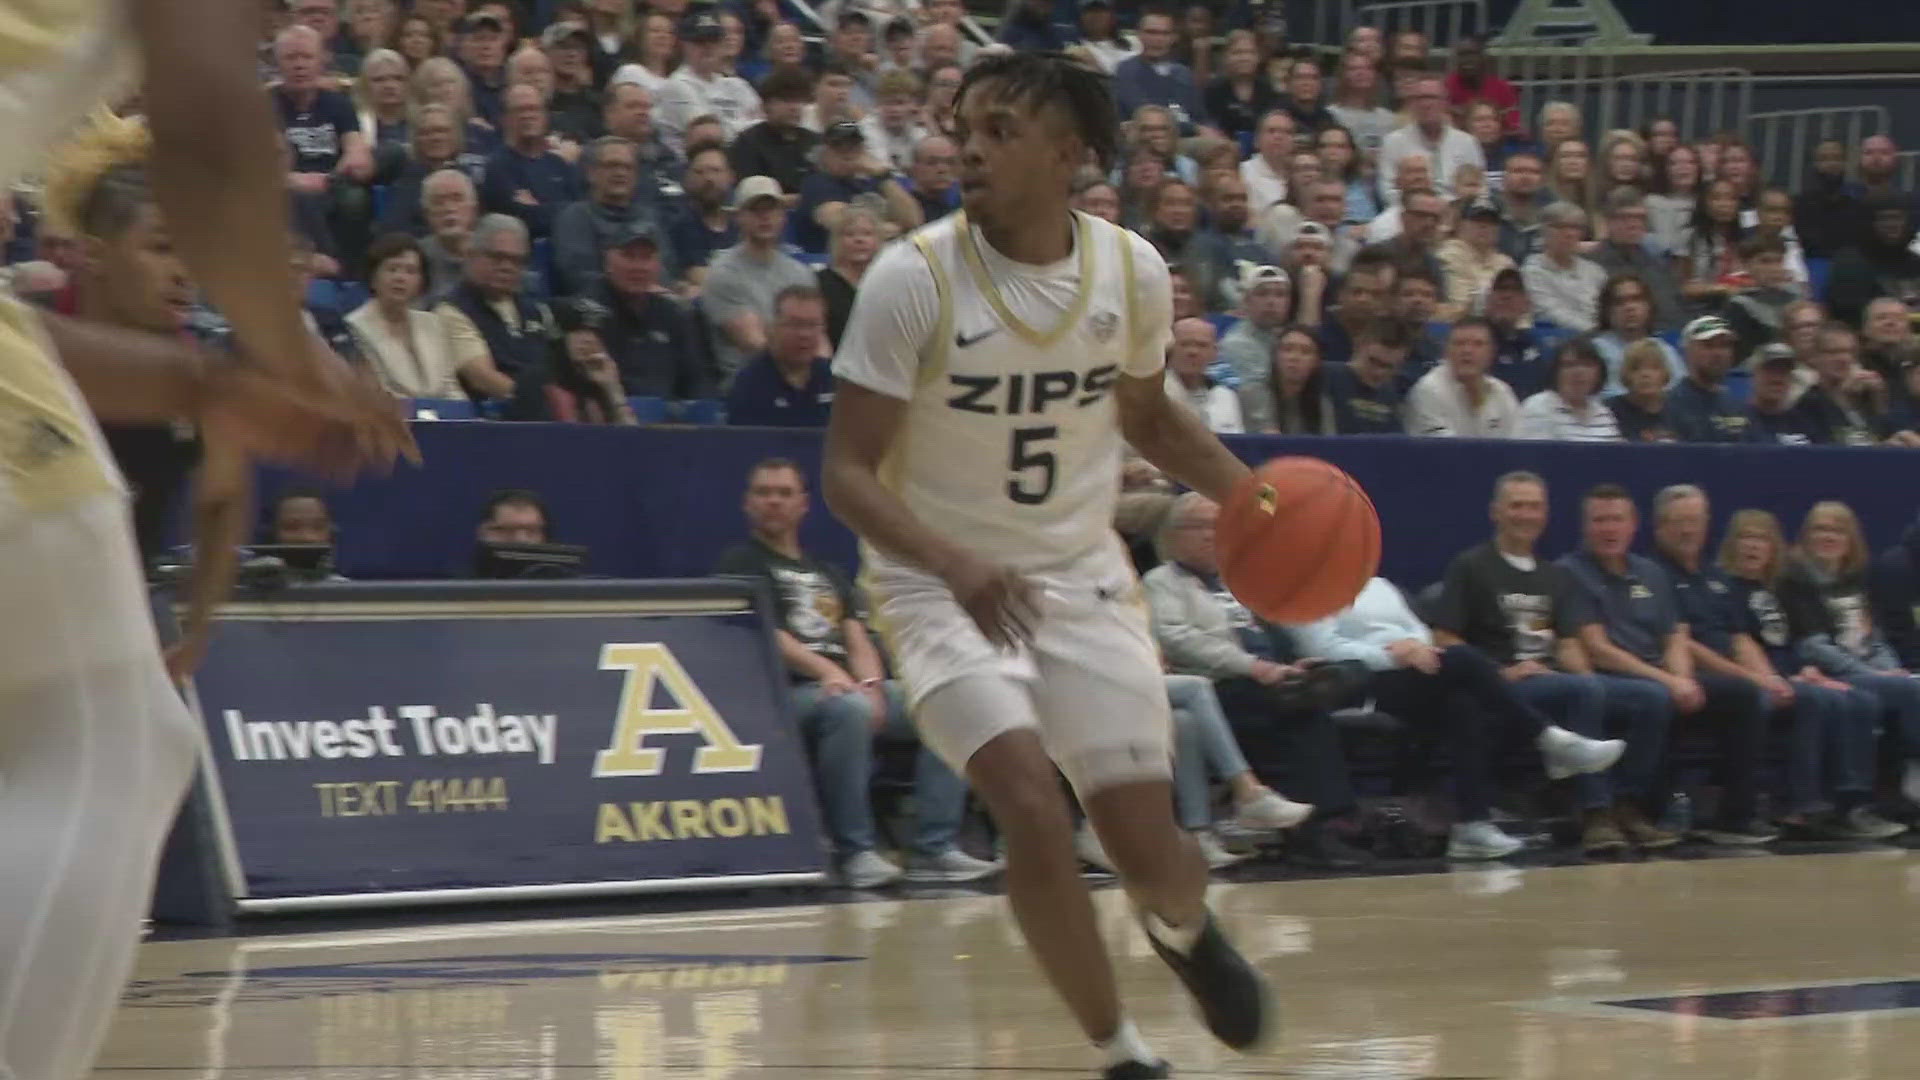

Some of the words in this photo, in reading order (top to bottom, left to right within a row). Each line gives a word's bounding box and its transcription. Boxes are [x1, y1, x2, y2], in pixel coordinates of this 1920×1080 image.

[945, 363, 1118, 415] ZIPS
[1006, 426, 1058, 505] 5
[223, 706, 404, 760] Invest
[398, 704, 557, 764] Today
[591, 642, 764, 778] A
[314, 781, 402, 817] TEXT
[407, 777, 509, 814] 41444
[595, 796, 790, 843] AKRON
